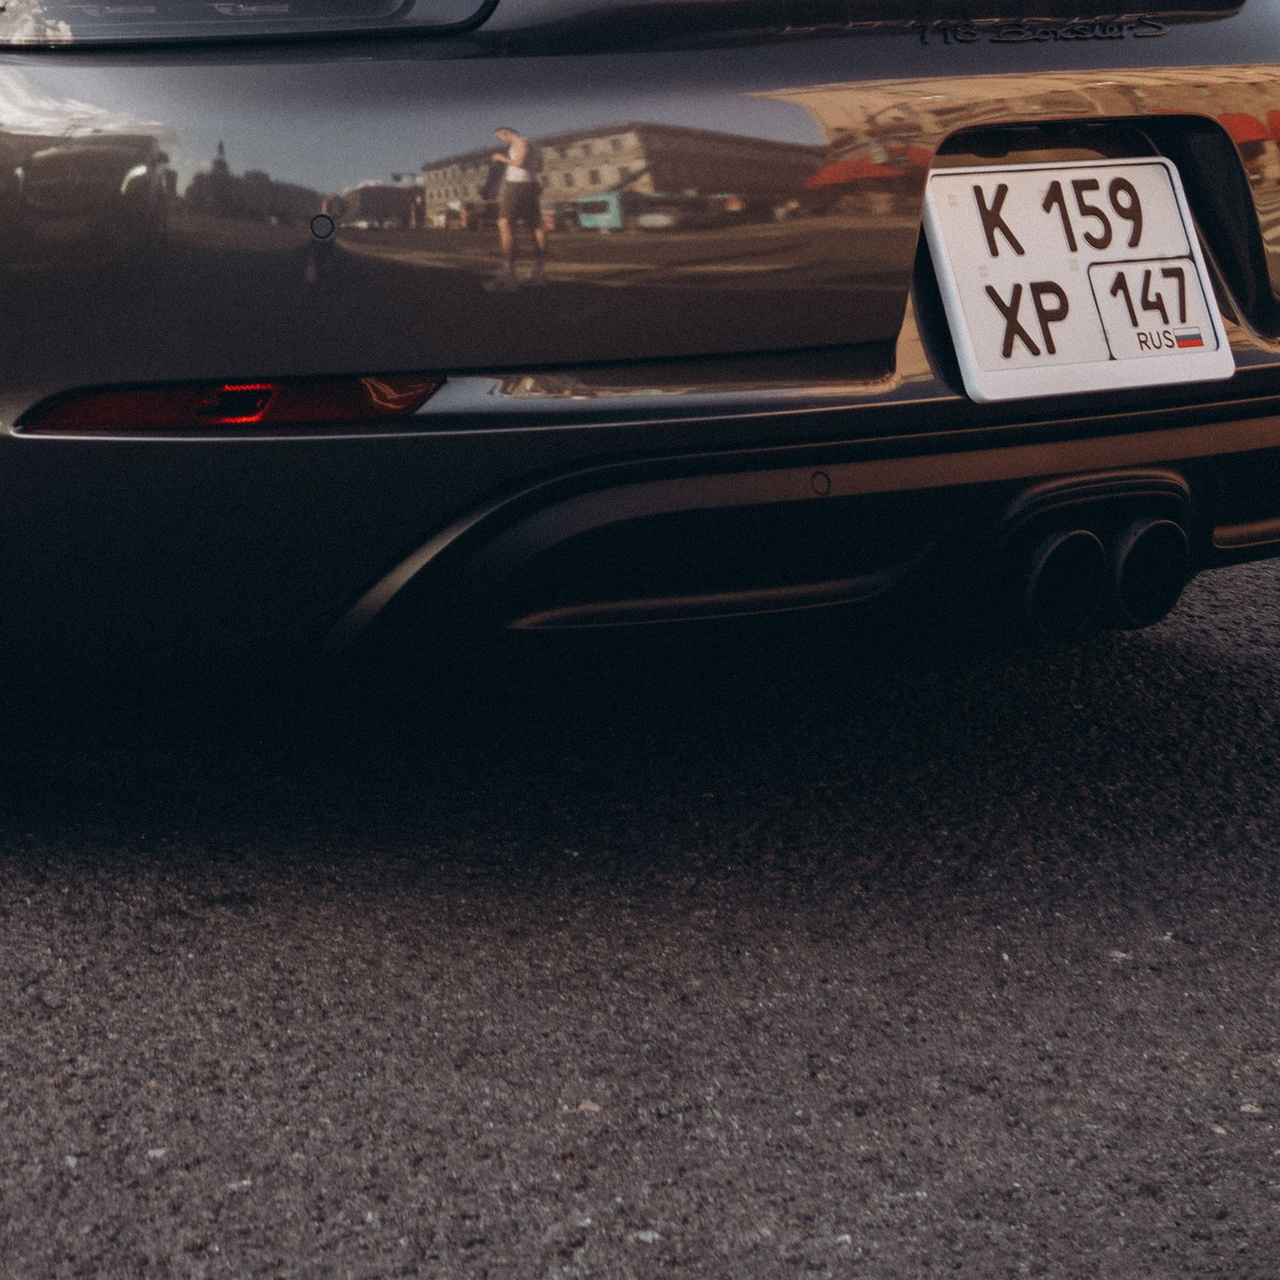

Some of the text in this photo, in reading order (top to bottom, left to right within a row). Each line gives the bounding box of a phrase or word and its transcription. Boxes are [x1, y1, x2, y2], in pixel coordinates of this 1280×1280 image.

[1041, 177, 1143, 253] 159
[1109, 266, 1187, 328] 147
[1136, 329, 1175, 352] RUS
